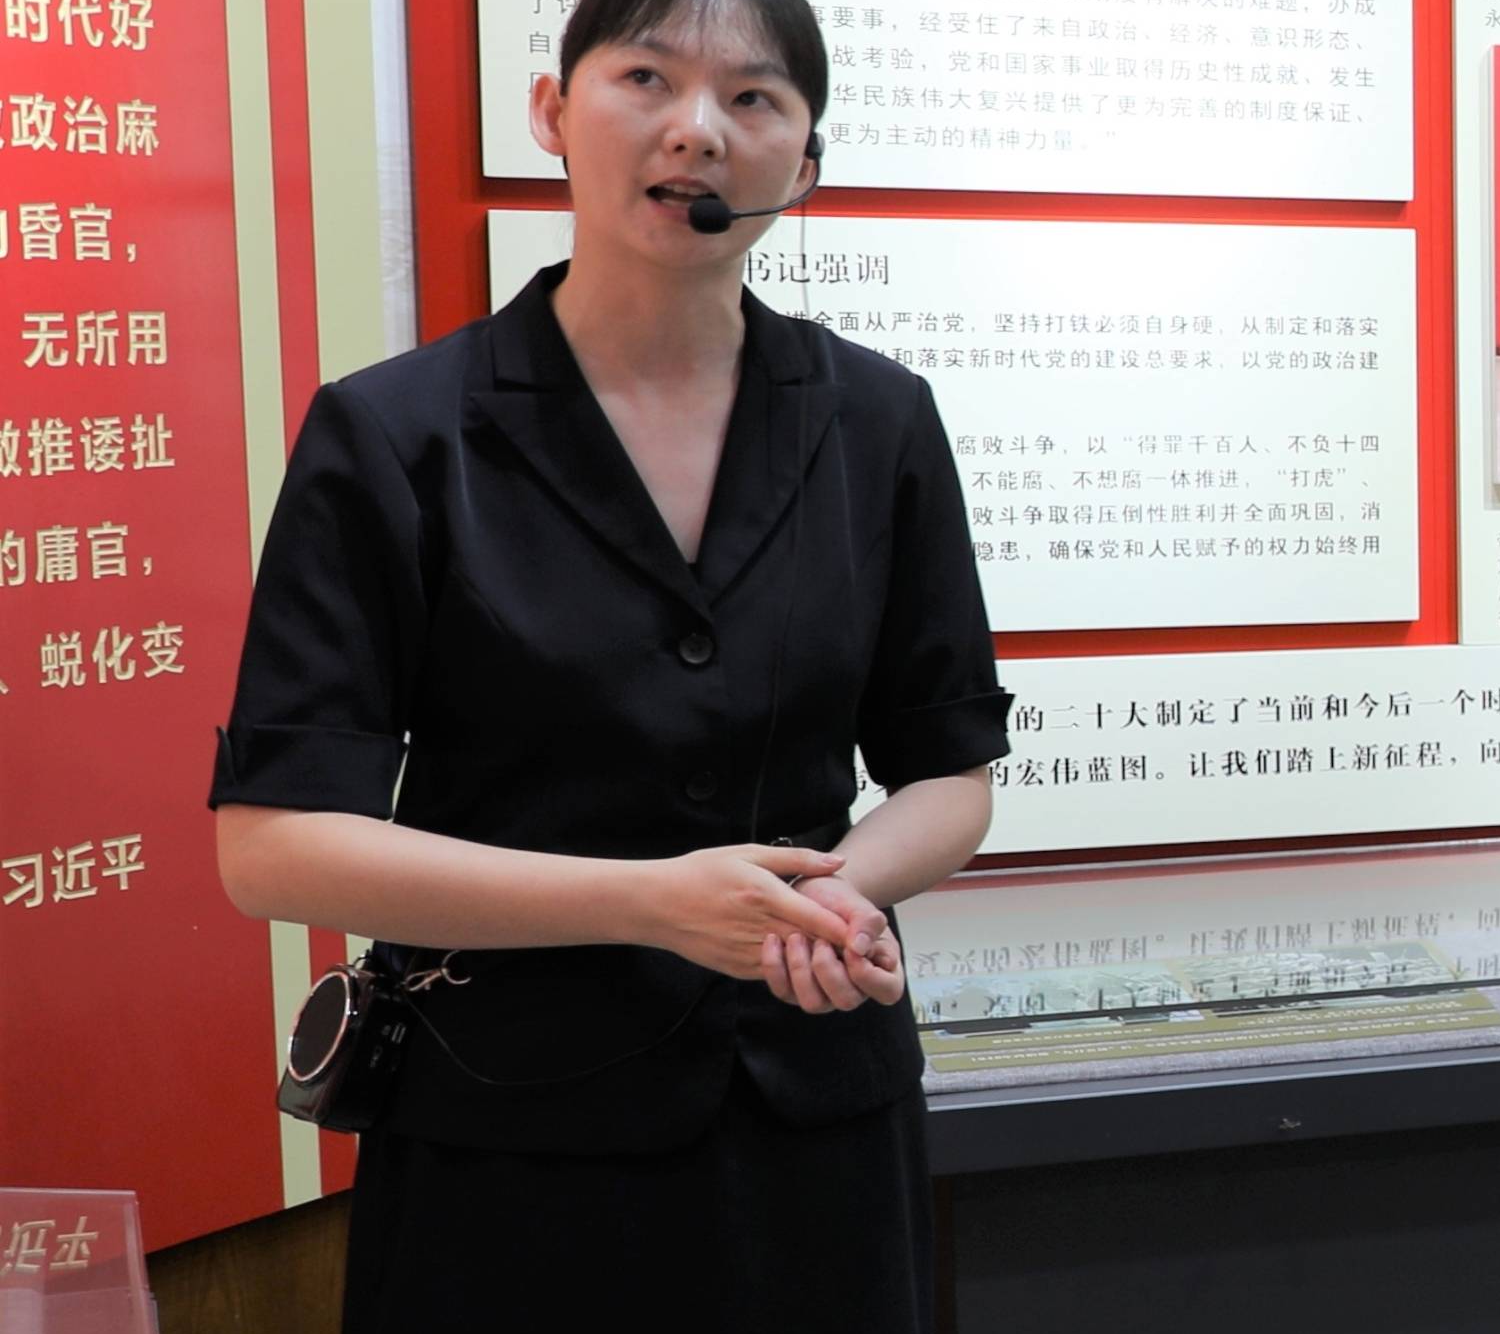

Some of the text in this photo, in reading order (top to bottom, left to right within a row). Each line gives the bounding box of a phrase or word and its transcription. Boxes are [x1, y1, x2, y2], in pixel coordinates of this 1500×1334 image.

[0, 92, 161, 159] 政治麻
[0, 200, 138, 265] 昏官，
[21, 308, 169, 371] 无所用
[0, 831, 146, 911] 习近平
